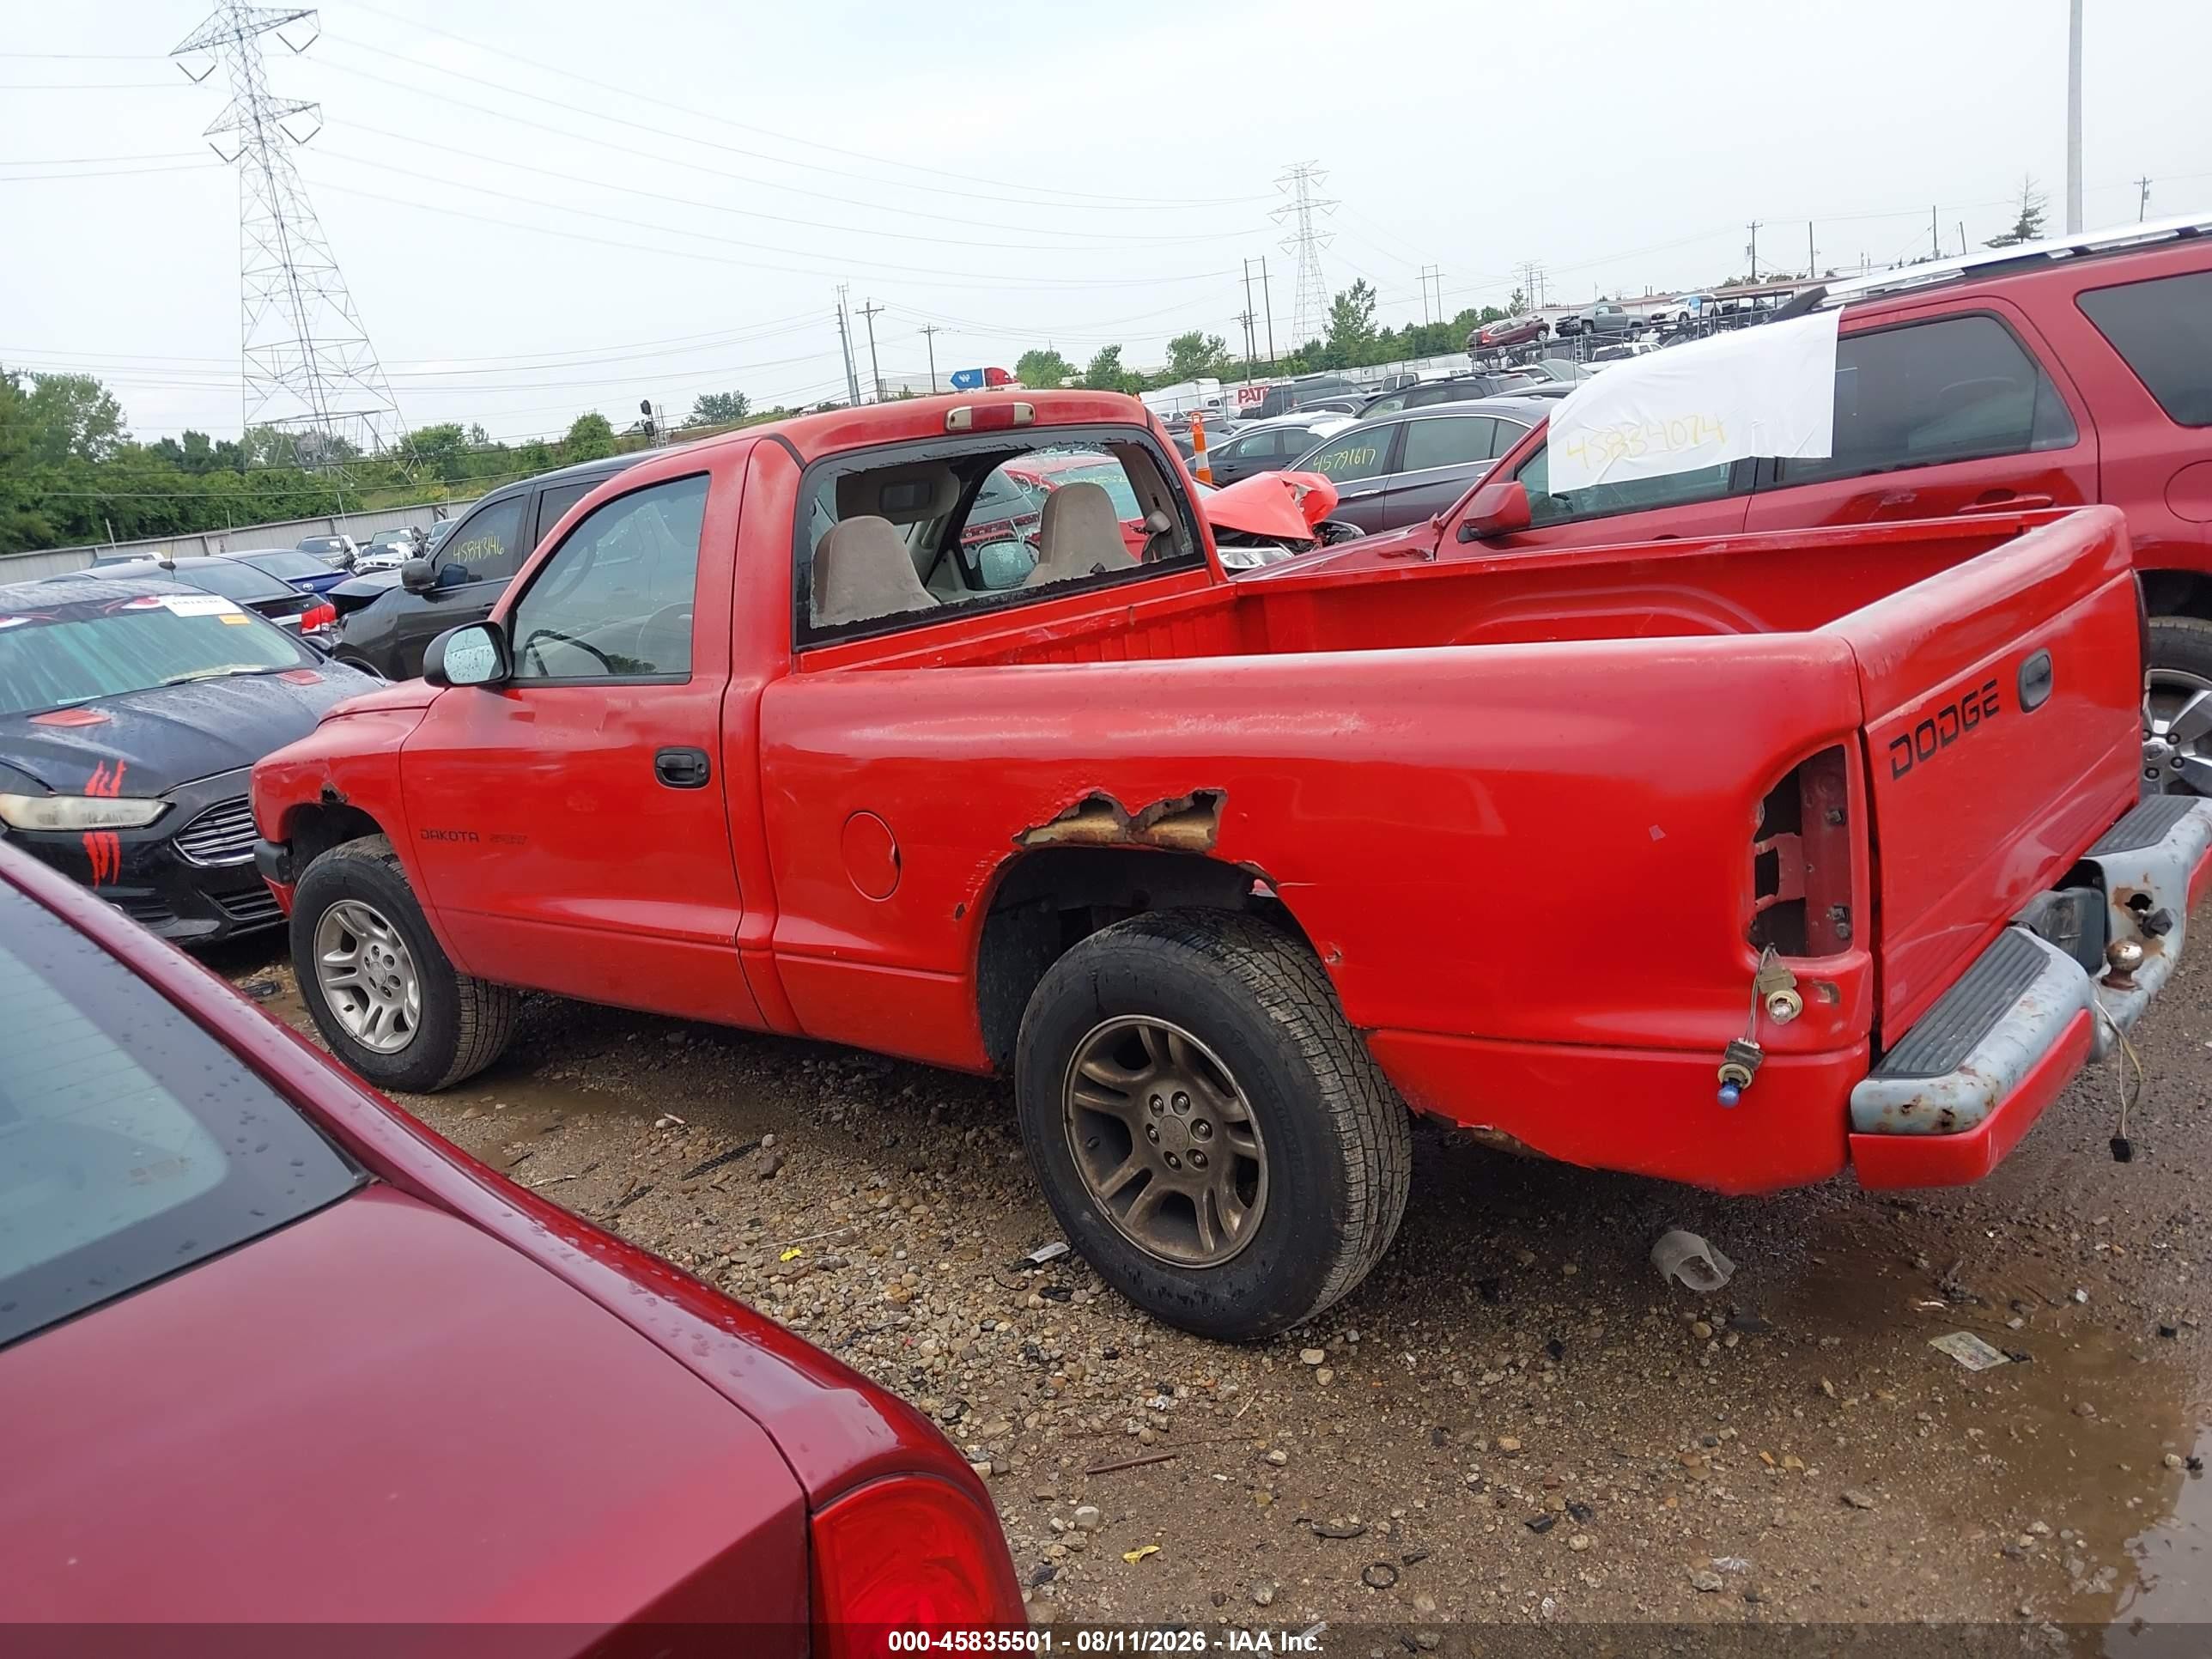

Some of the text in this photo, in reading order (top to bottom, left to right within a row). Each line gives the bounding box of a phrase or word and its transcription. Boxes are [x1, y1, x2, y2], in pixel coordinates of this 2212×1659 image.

[1313, 448, 1376, 474] 45791617
[453, 535, 505, 563] 45843146
[1889, 678, 2000, 781] DODGE
[420, 829, 480, 842] DAKOTA
